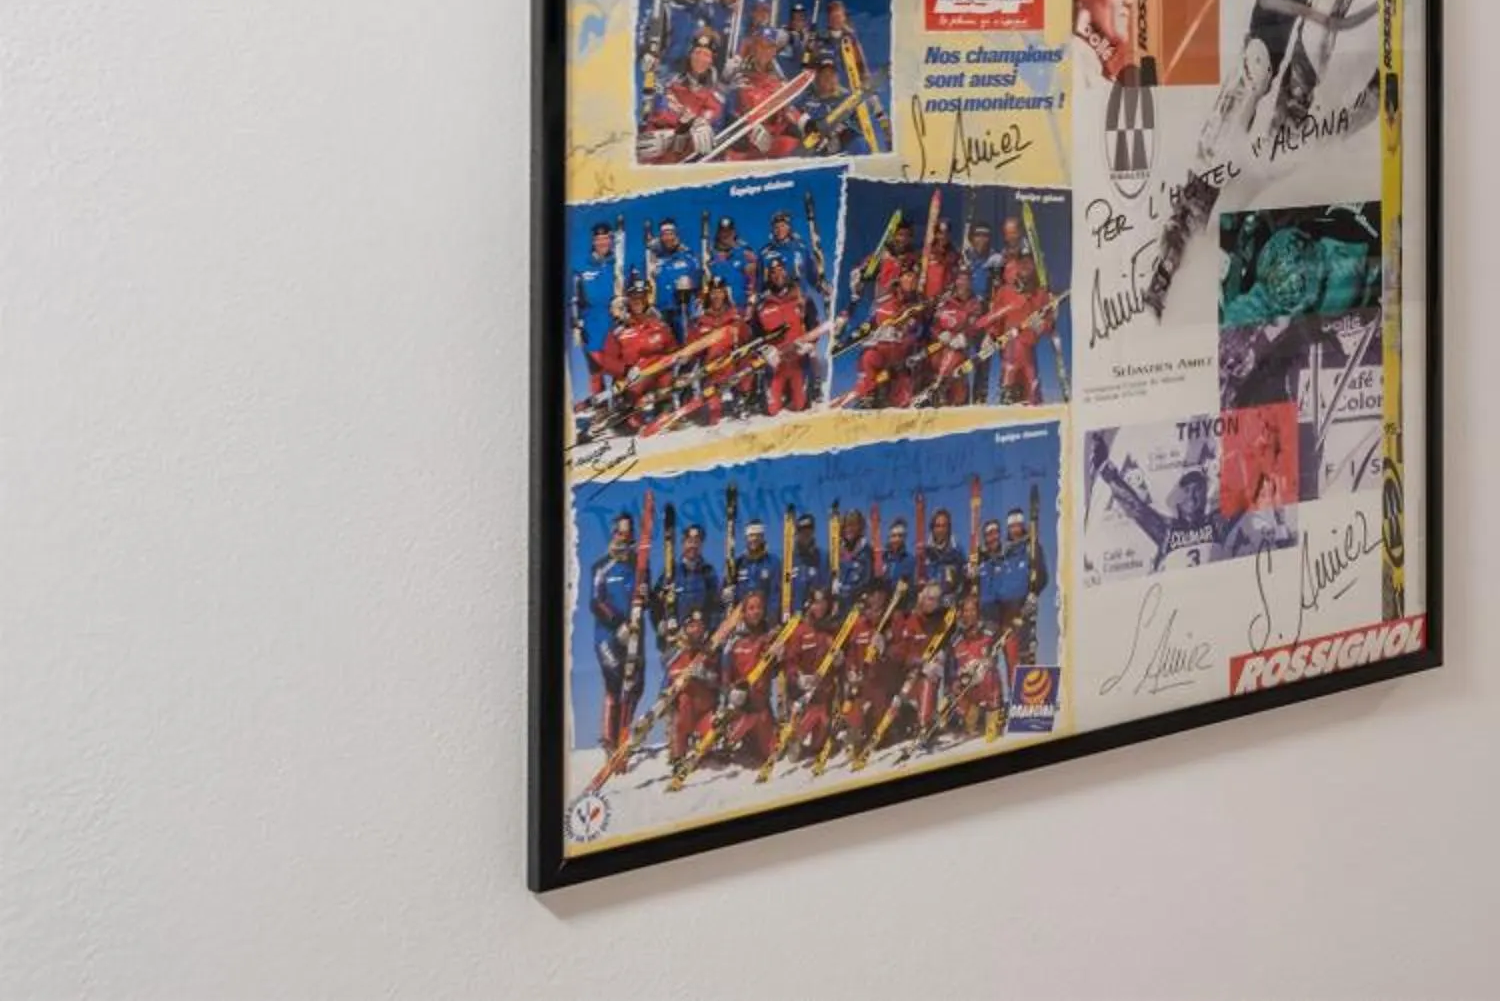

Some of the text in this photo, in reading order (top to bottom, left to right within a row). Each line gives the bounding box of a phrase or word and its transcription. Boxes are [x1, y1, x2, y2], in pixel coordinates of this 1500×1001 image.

[924, 44, 1063, 67] Nos champions
[923, 69, 1017, 89] sont aussi
[925, 97, 957, 112] nos
[963, 93, 1053, 111] moniteurs
[1176, 417, 1240, 441] THYON
[1233, 618, 1425, 696] ROSSIGNOL
